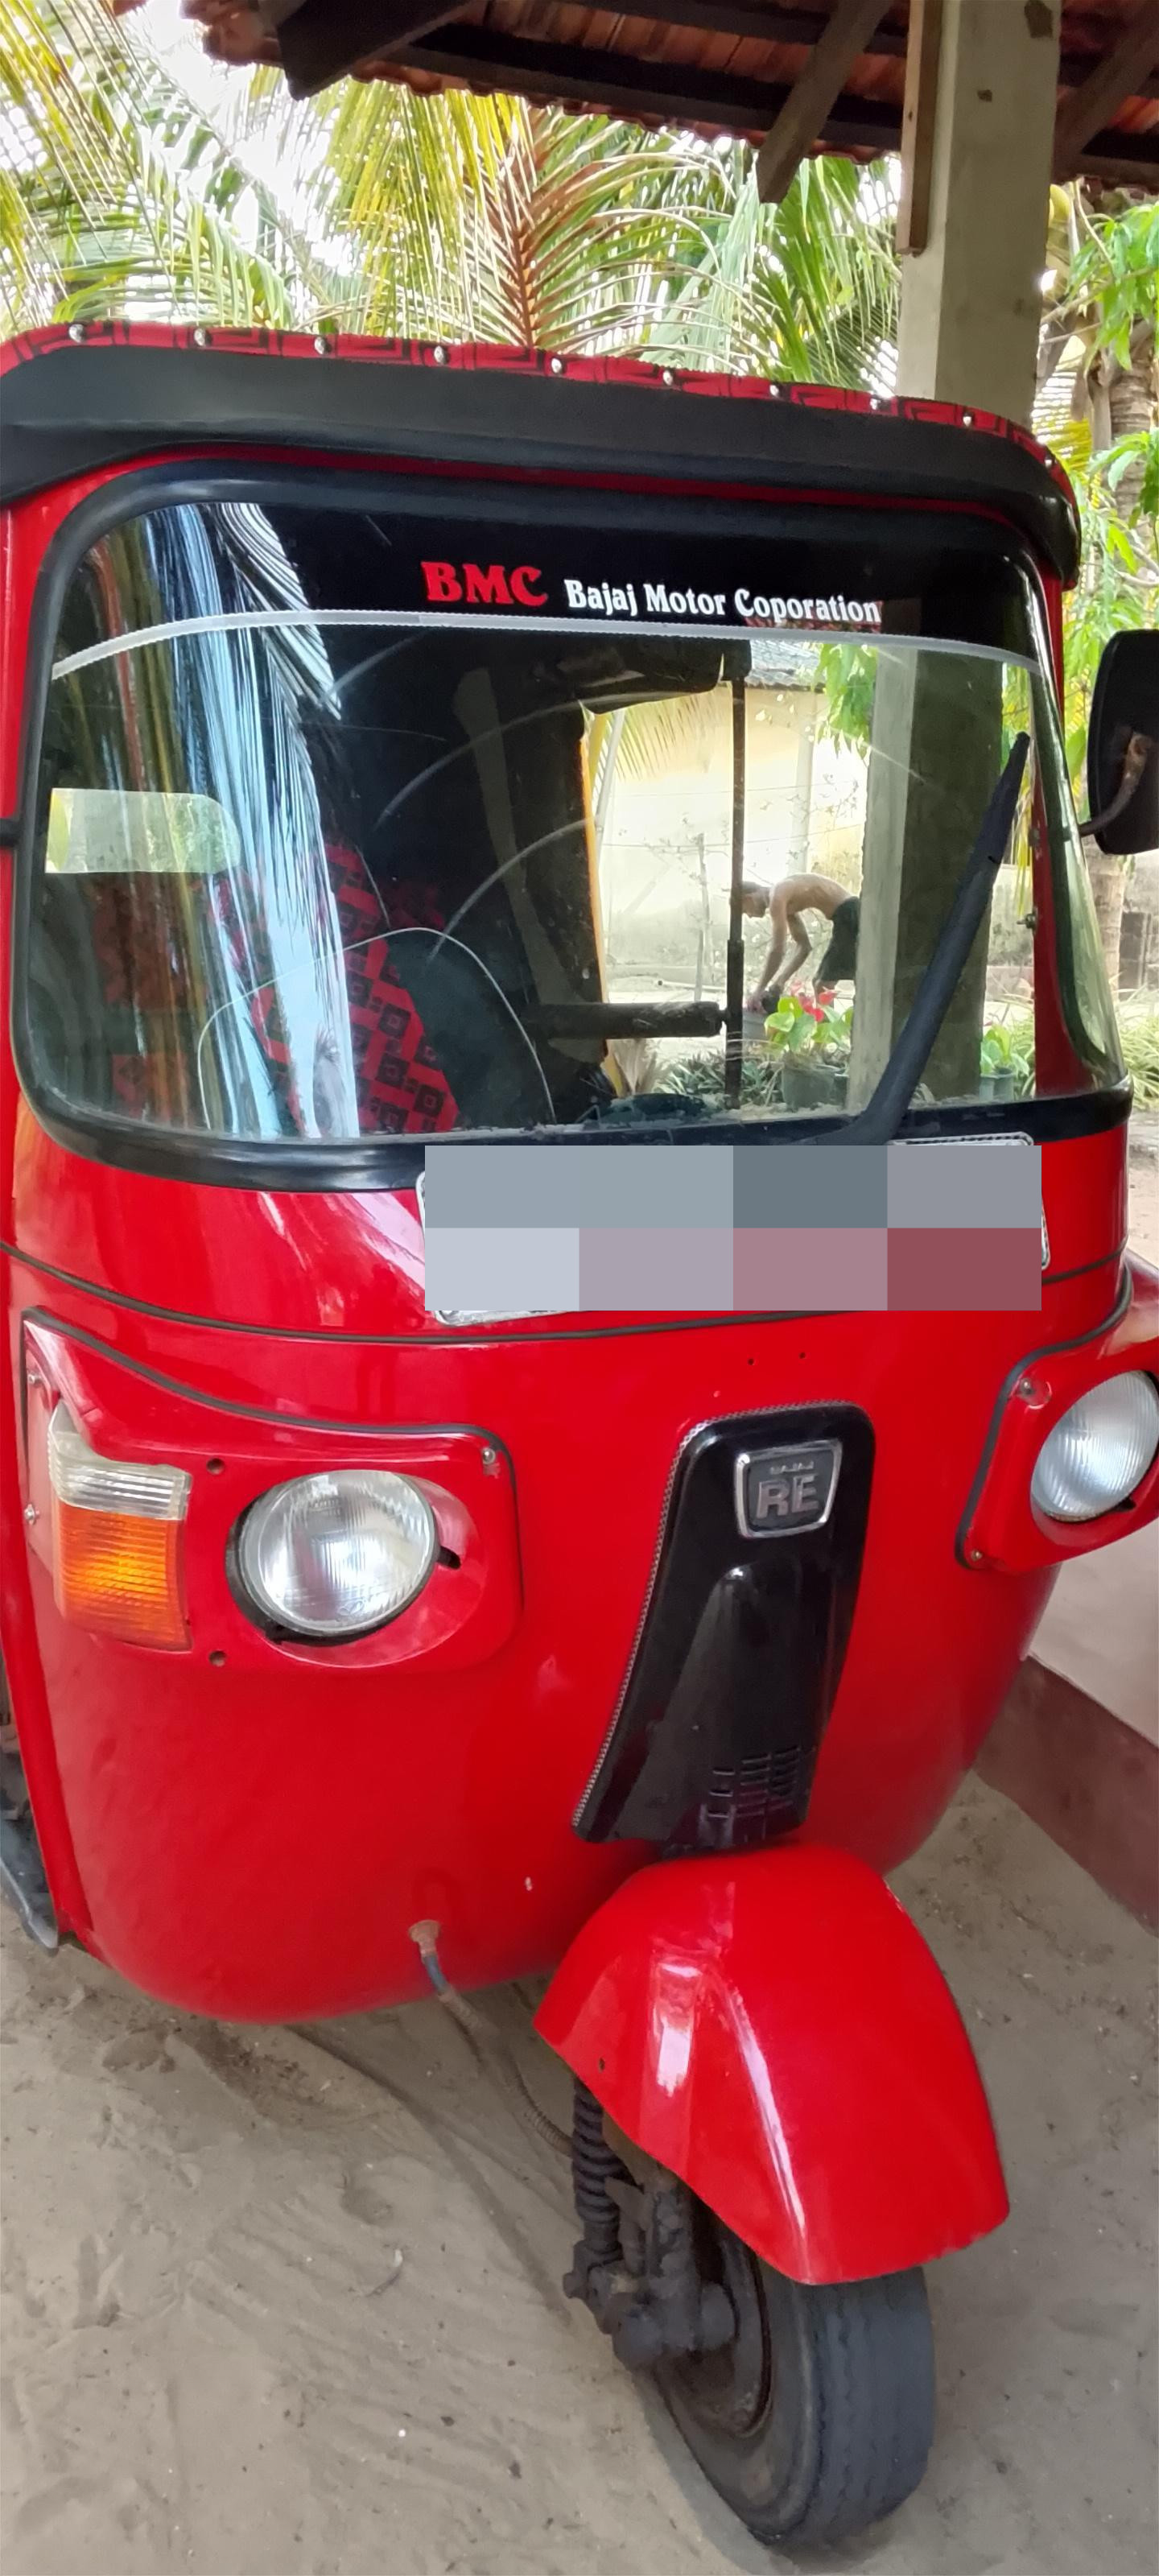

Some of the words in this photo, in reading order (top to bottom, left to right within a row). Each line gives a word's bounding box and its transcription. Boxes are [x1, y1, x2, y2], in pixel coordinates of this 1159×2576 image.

[420, 561, 549, 606] BMC
[563, 579, 638, 617] Bajaj
[643, 583, 726, 616] Motor
[733, 588, 882, 622] Coporation
[756, 1474, 819, 1519] RE
